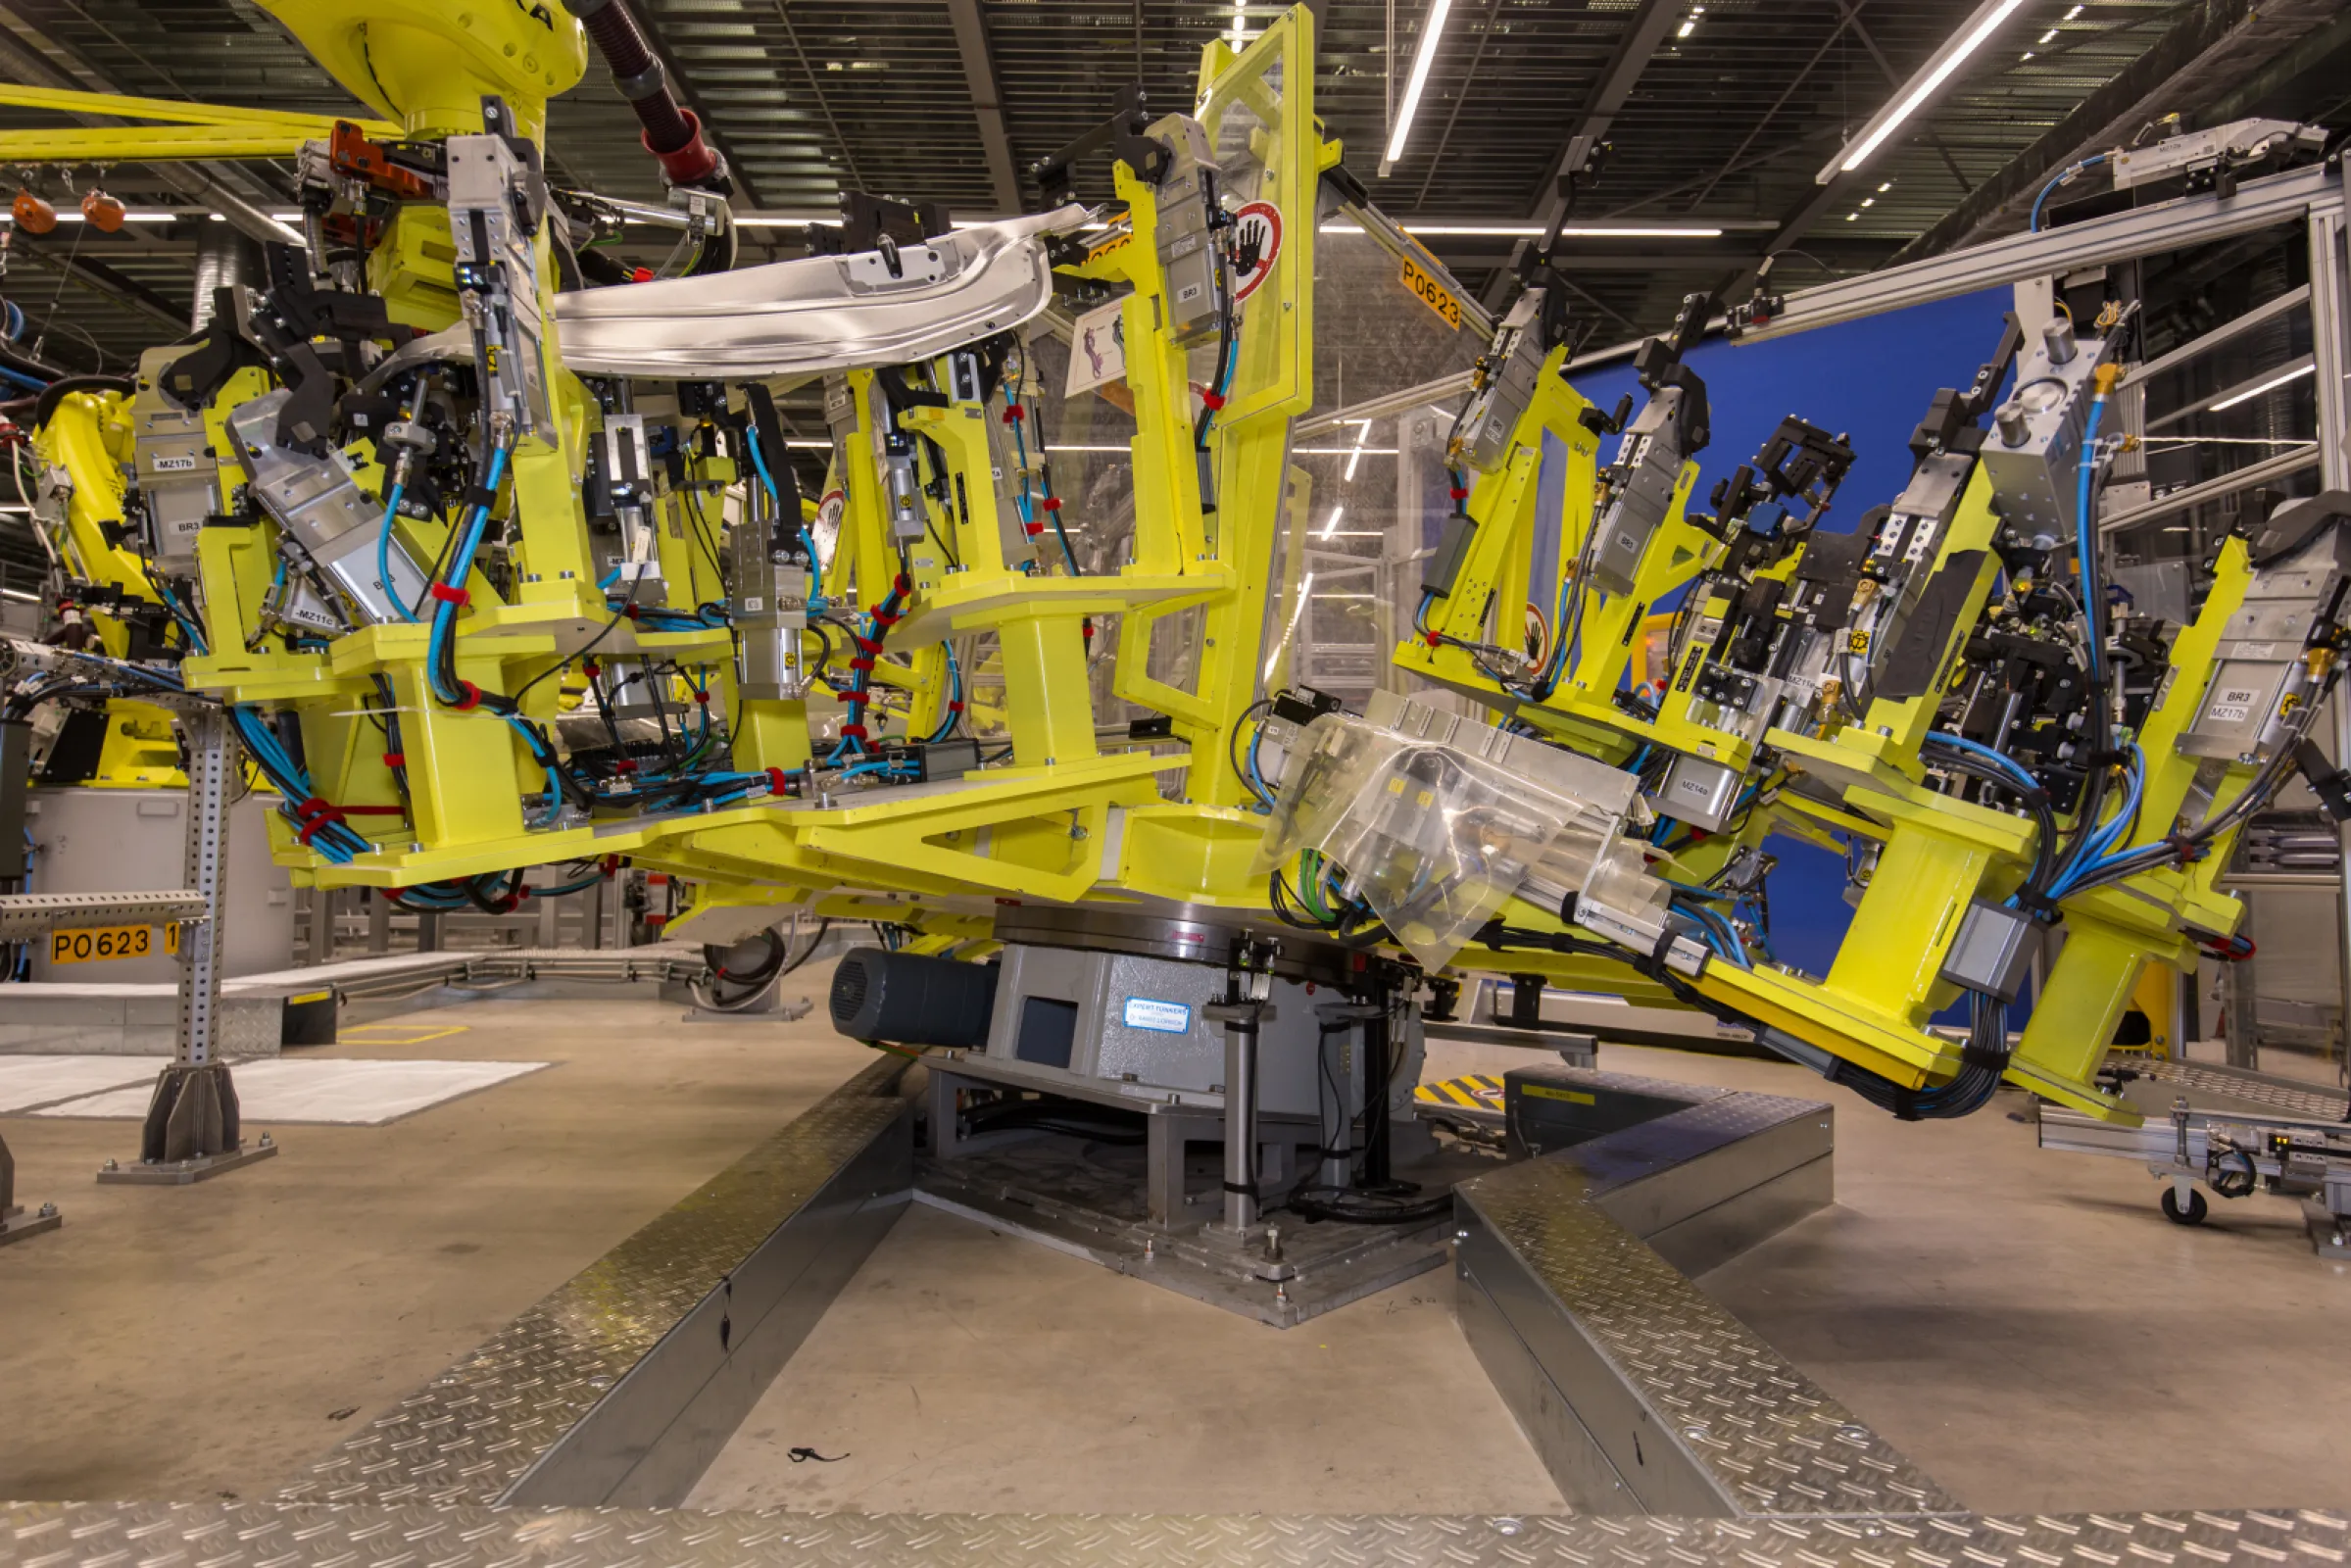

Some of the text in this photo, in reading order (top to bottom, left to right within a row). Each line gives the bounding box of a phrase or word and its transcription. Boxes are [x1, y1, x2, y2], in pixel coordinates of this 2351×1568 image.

[1183, 287, 1198, 299] BR3
[178, 522, 199, 531] BR3
[295, 610, 333, 625] -MZ11c
[2227, 692, 2251, 703] BR3
[2211, 708, 2245, 718] MZ17b
